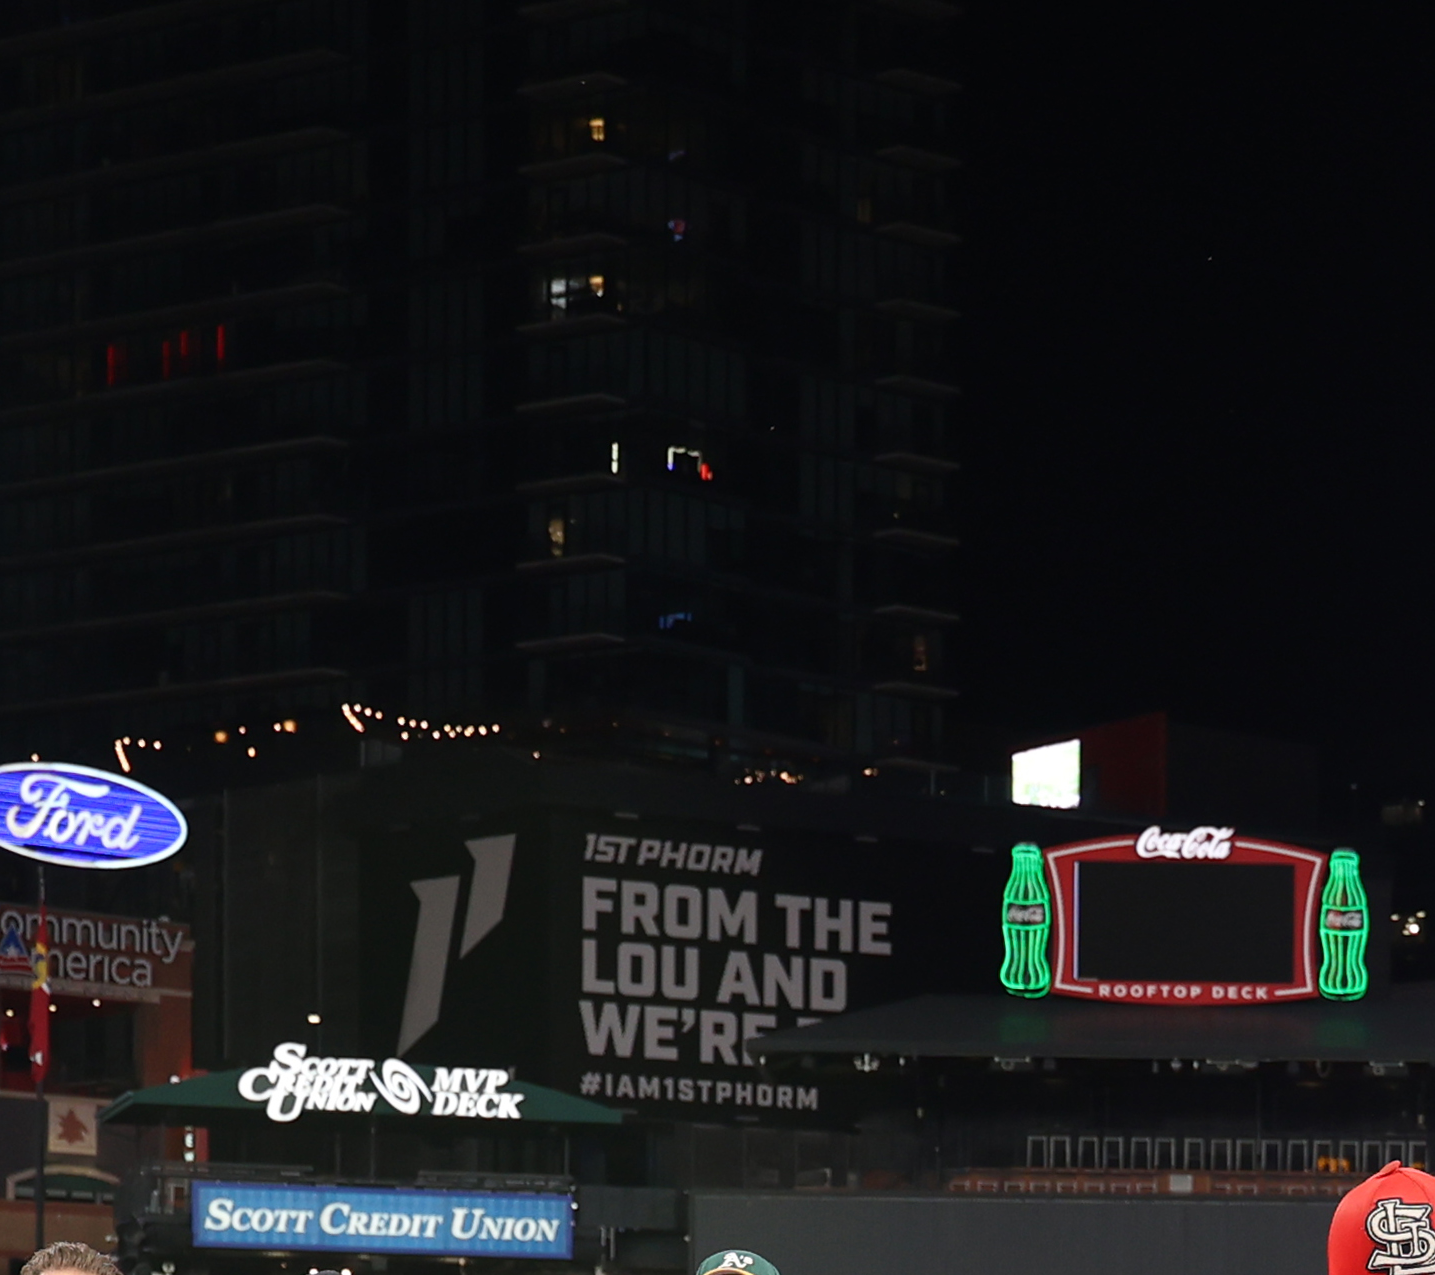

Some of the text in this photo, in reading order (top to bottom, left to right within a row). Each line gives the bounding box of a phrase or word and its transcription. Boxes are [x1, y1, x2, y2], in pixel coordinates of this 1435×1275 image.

[5, 773, 143, 852] Ford
[584, 833, 763, 876] 1ST PHORM
[1135, 825, 1236, 860] Coca-Cola
[582, 876, 893, 956] FROM THE
[582, 938, 848, 1013] LOU AND
[1098, 983, 1269, 1001] ROOFTOP DECK
[270, 1042, 509, 1093] SCOTT MVP
[430, 1092, 525, 1119] DECK
[580, 1071, 819, 1111] #IAM1STPHORM
[205, 1197, 560, 1244] SCOTT CREDIT UNION
